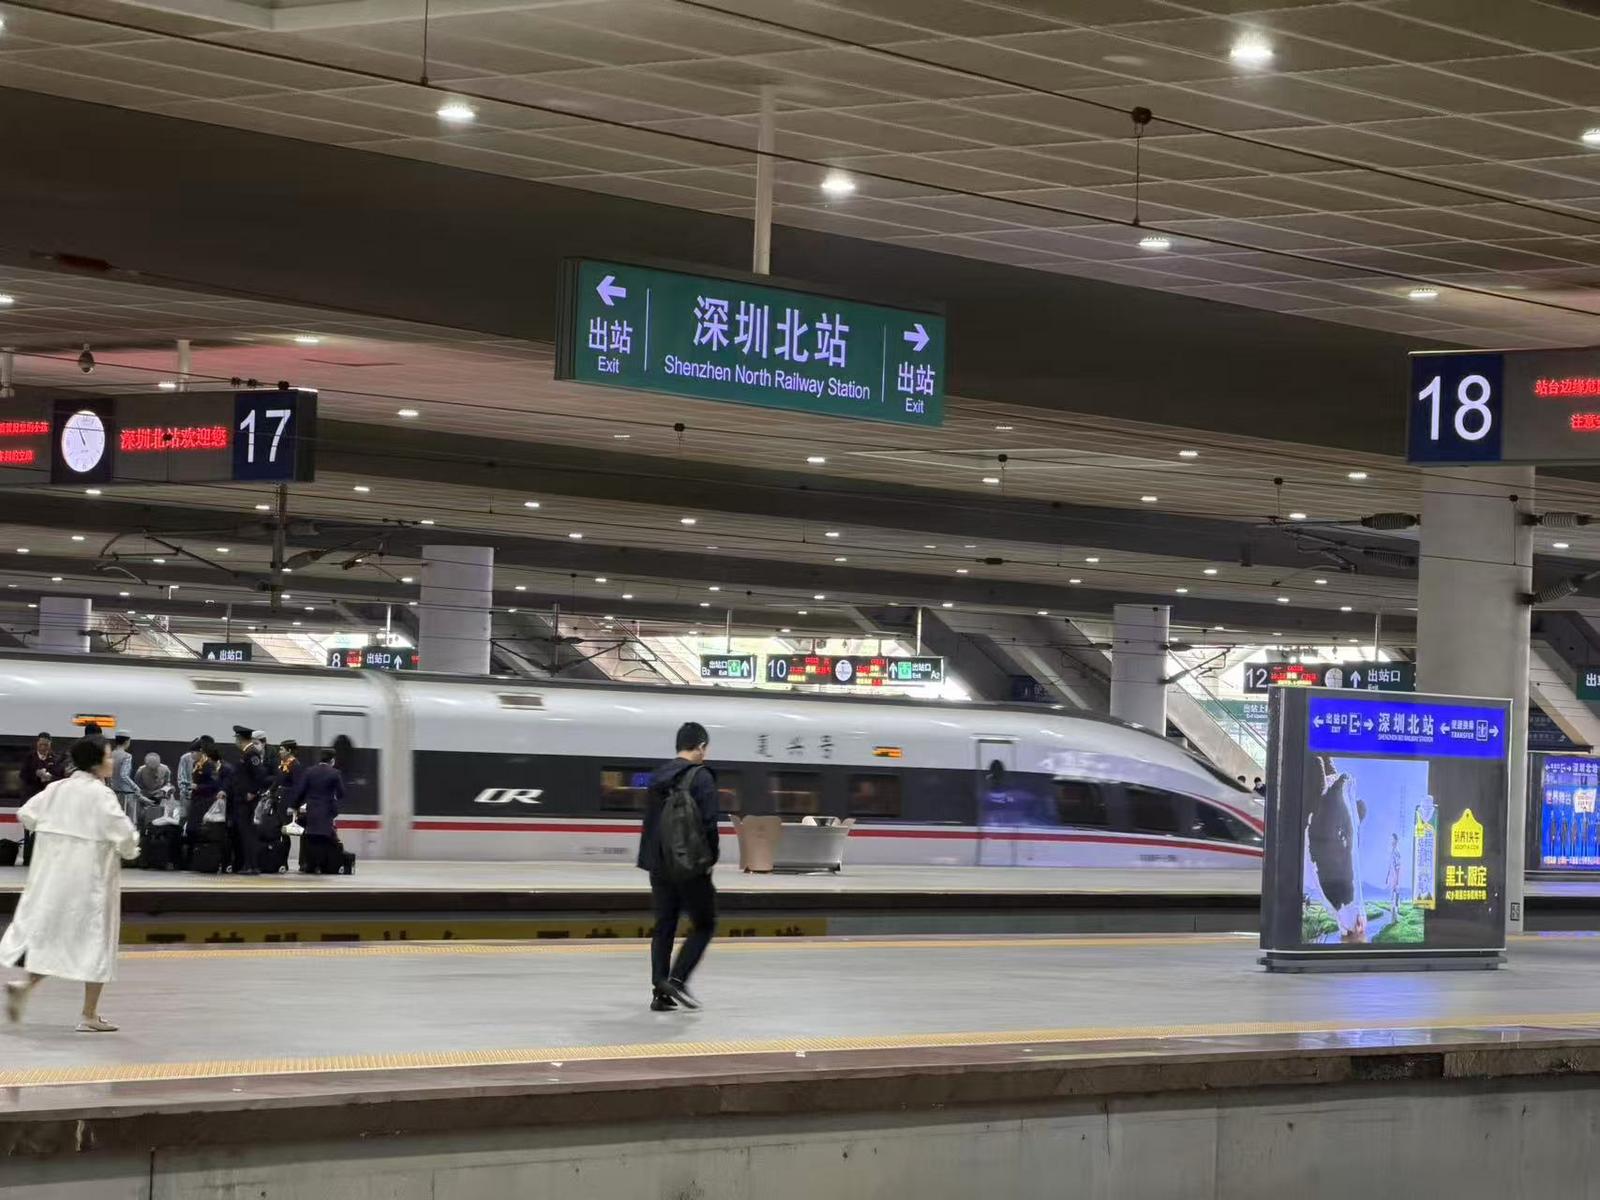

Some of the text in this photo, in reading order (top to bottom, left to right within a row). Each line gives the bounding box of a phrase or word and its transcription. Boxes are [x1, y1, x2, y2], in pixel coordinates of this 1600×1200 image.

[588, 316, 633, 355] 出站
[692, 295, 850, 368] 深圳北站
[597, 356, 620, 374] Exit
[664, 355, 871, 400] Shenzhen North Railway Station
[897, 360, 936, 396] 出站
[905, 396, 925, 414] Exit
[1418, 373, 1493, 441] 18
[120, 425, 228, 450] 深圳北站欢迎您
[239, 409, 292, 463] 17
[219, 649, 243, 661] 出站口
[331, 652, 341, 668] 8
[366, 653, 391, 665] 出站口
[701, 666, 711, 676] B2
[767, 659, 787, 679] 10
[930, 670, 941, 680] A2
[1245, 668, 1268, 689] 12
[1367, 669, 1401, 683] 出站口
[1378, 712, 1435, 736] 深圳北站
[473, 787, 544, 804] CR
